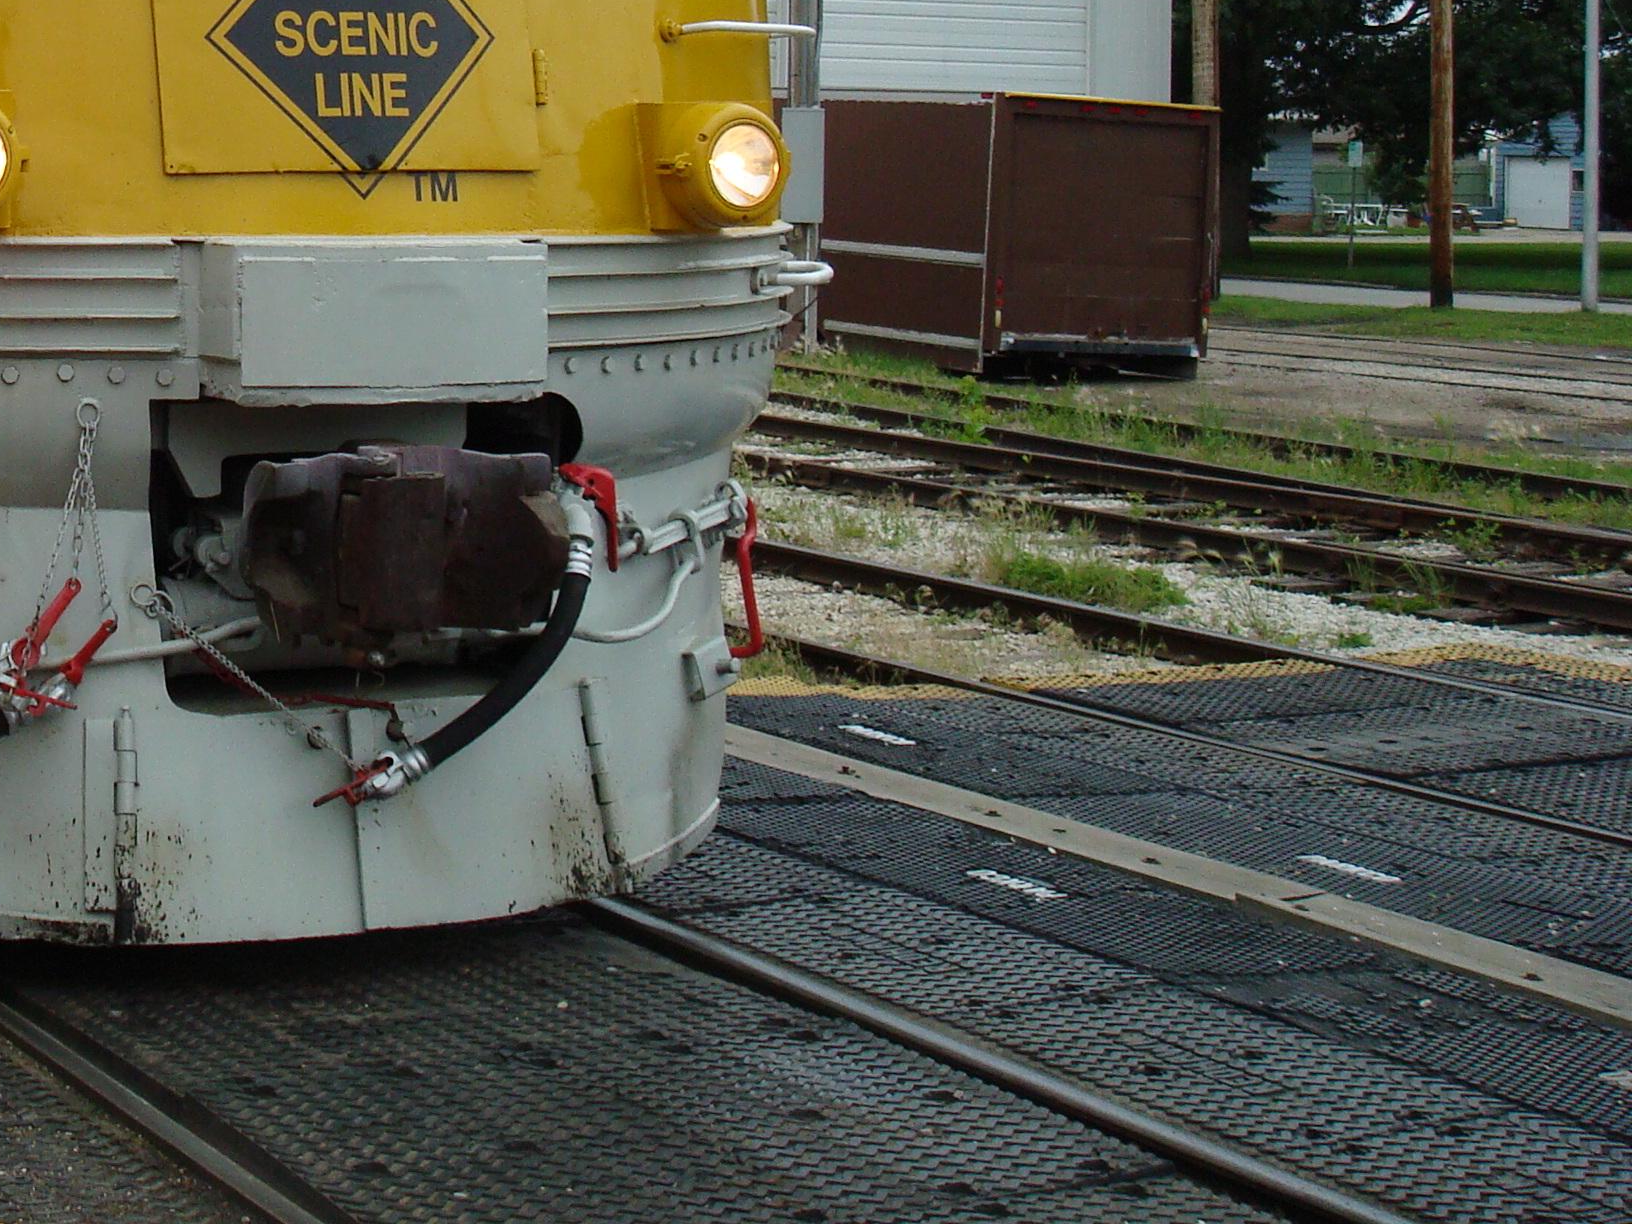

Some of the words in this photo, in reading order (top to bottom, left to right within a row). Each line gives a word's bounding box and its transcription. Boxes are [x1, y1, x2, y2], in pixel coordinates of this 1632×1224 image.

[274, 10, 439, 58] SCENIC
[315, 72, 410, 117] LINE
[408, 172, 458, 202] TM
